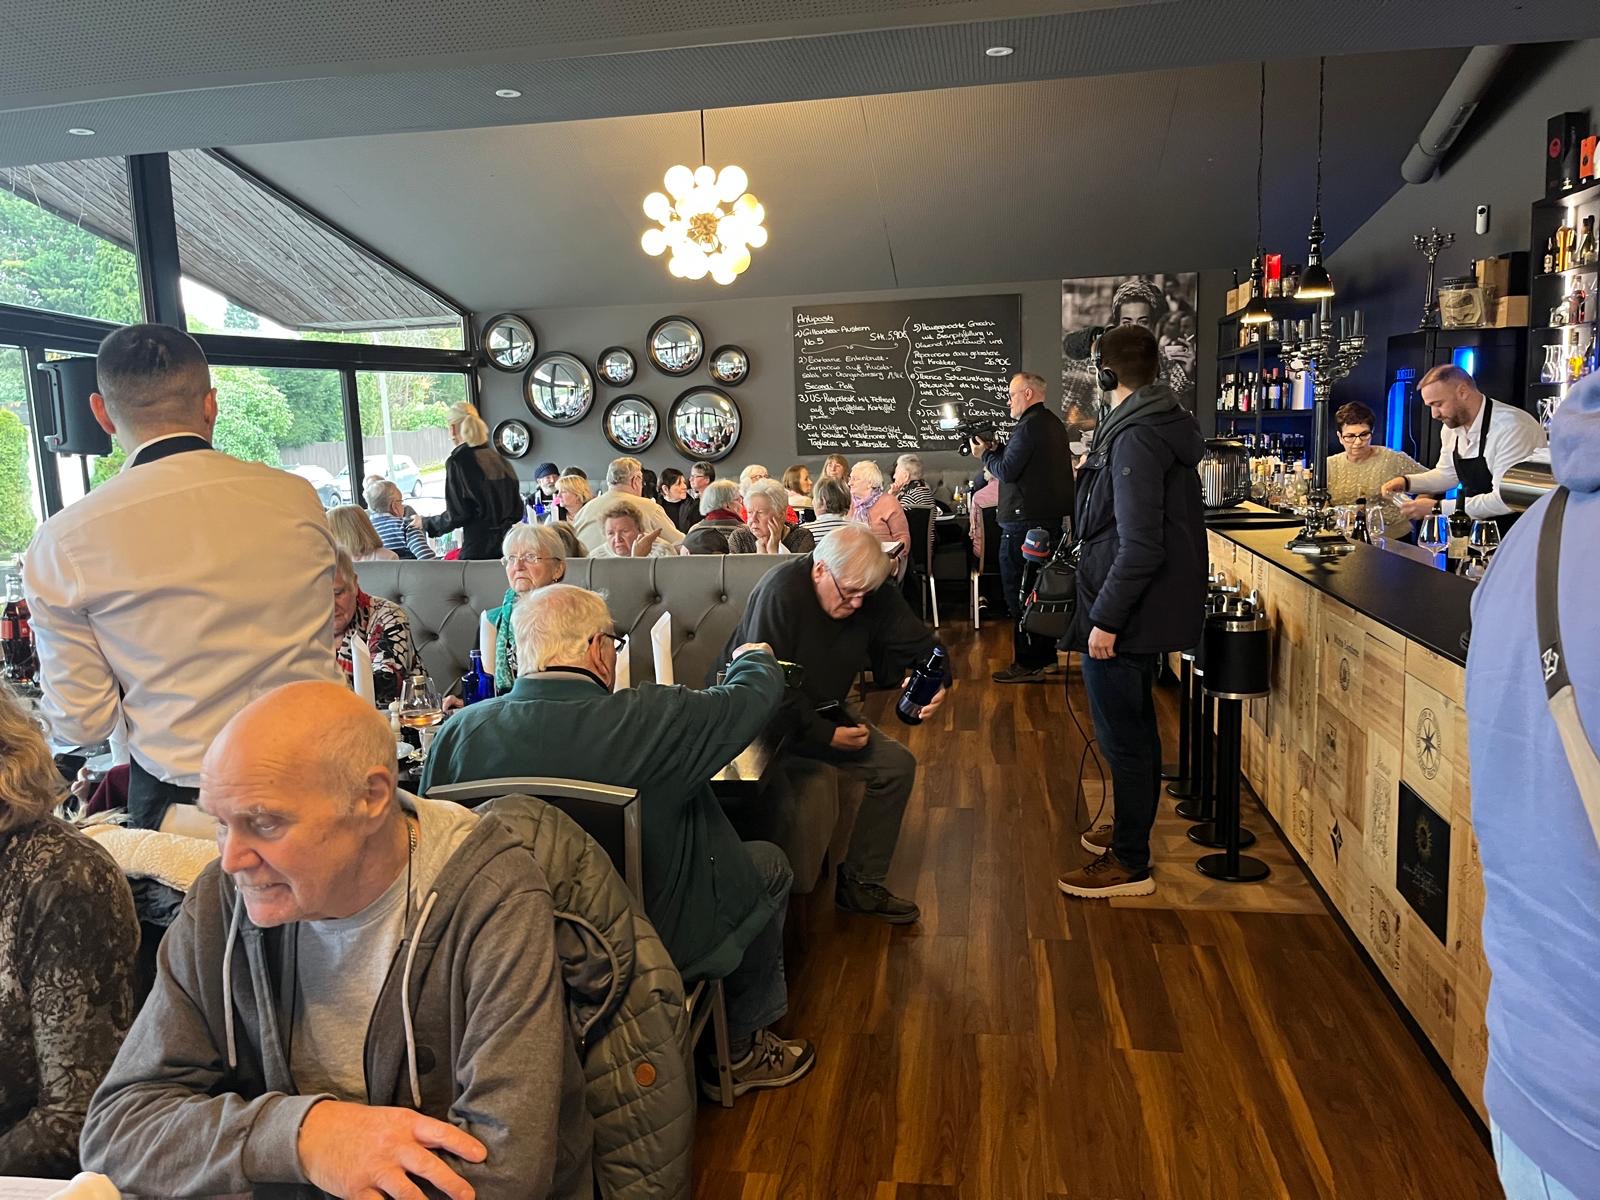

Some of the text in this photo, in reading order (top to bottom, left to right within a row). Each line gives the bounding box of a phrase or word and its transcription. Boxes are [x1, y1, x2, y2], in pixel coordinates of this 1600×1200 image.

[797, 314, 834, 325] Antipasti
[845, 364, 862, 373] auf
[798, 394, 809, 403] 3)
[810, 405, 825, 416] auf
[797, 423, 807, 431] 4)
